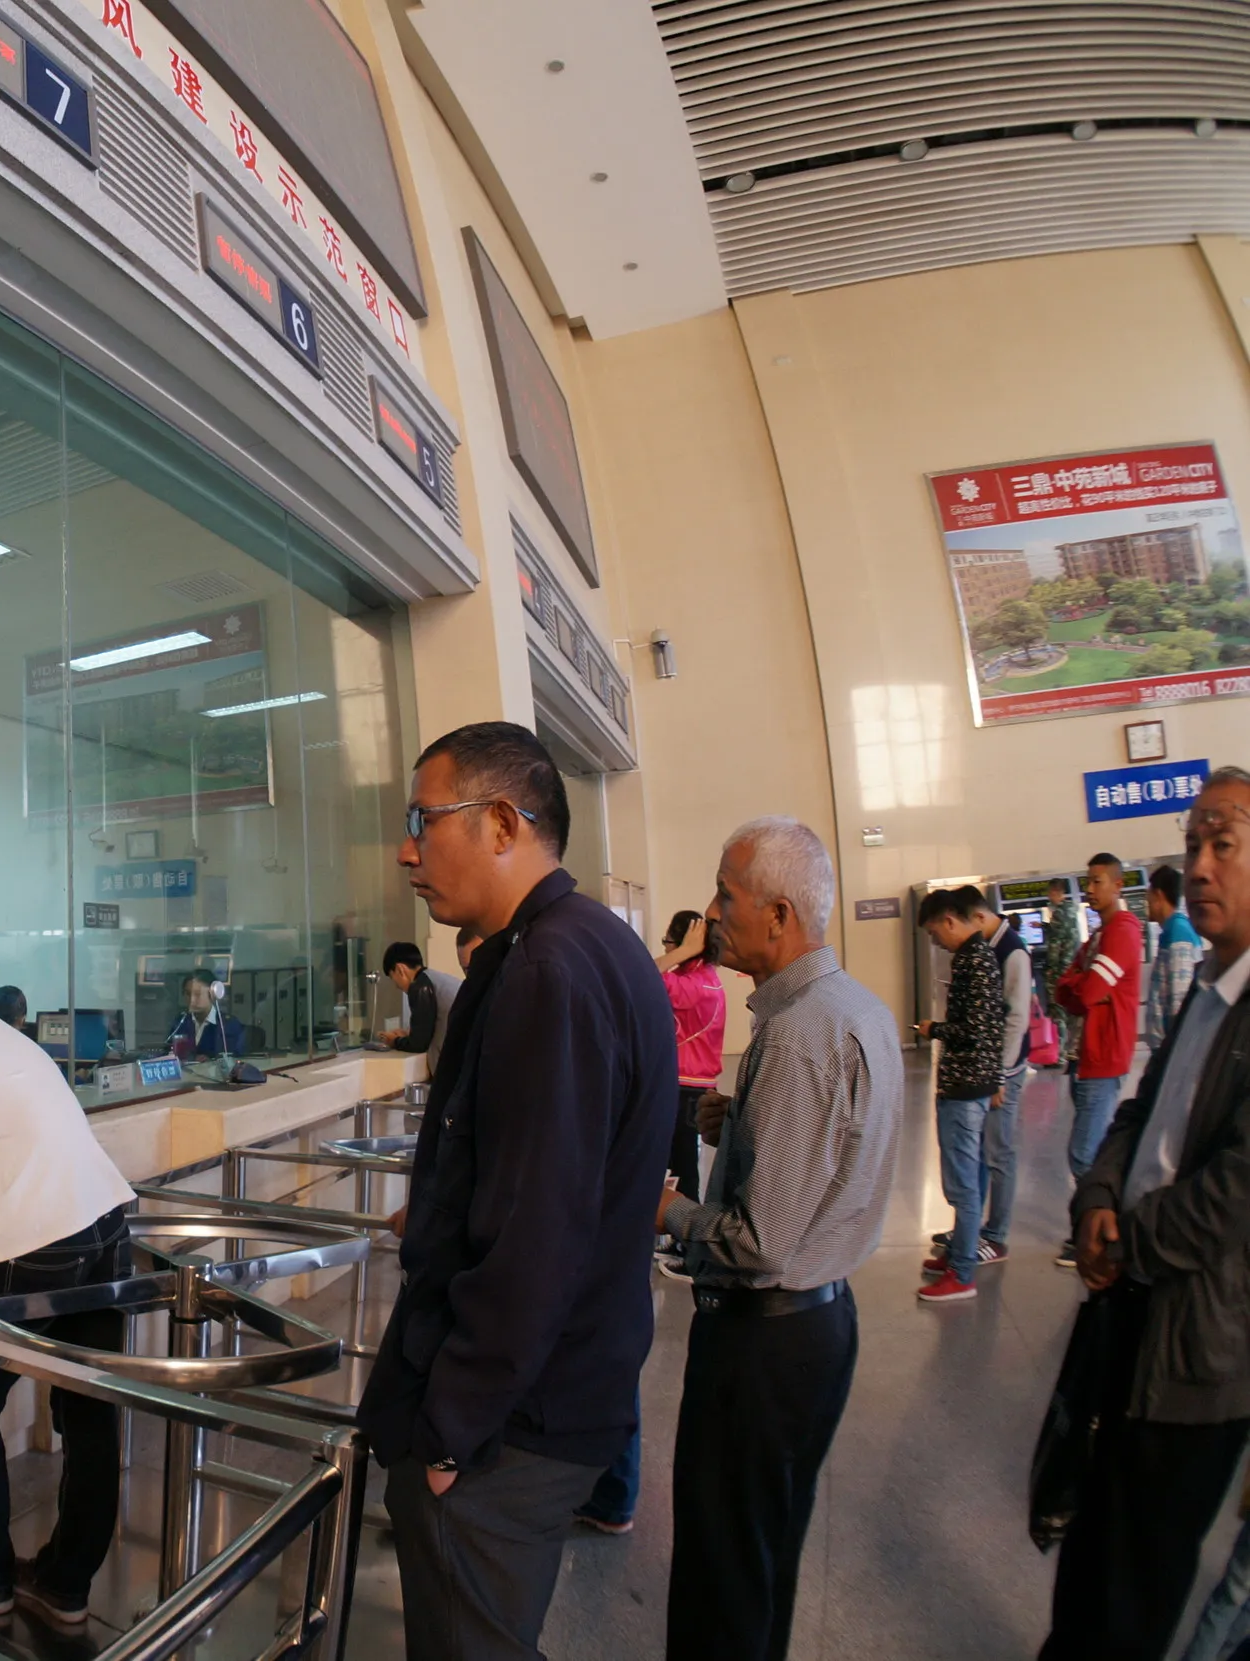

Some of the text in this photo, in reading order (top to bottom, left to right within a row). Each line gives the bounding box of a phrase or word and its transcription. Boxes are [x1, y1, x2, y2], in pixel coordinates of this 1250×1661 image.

[45, 68, 71, 125] 7
[291, 302, 309, 351] 6
[422, 446, 435, 487] 5
